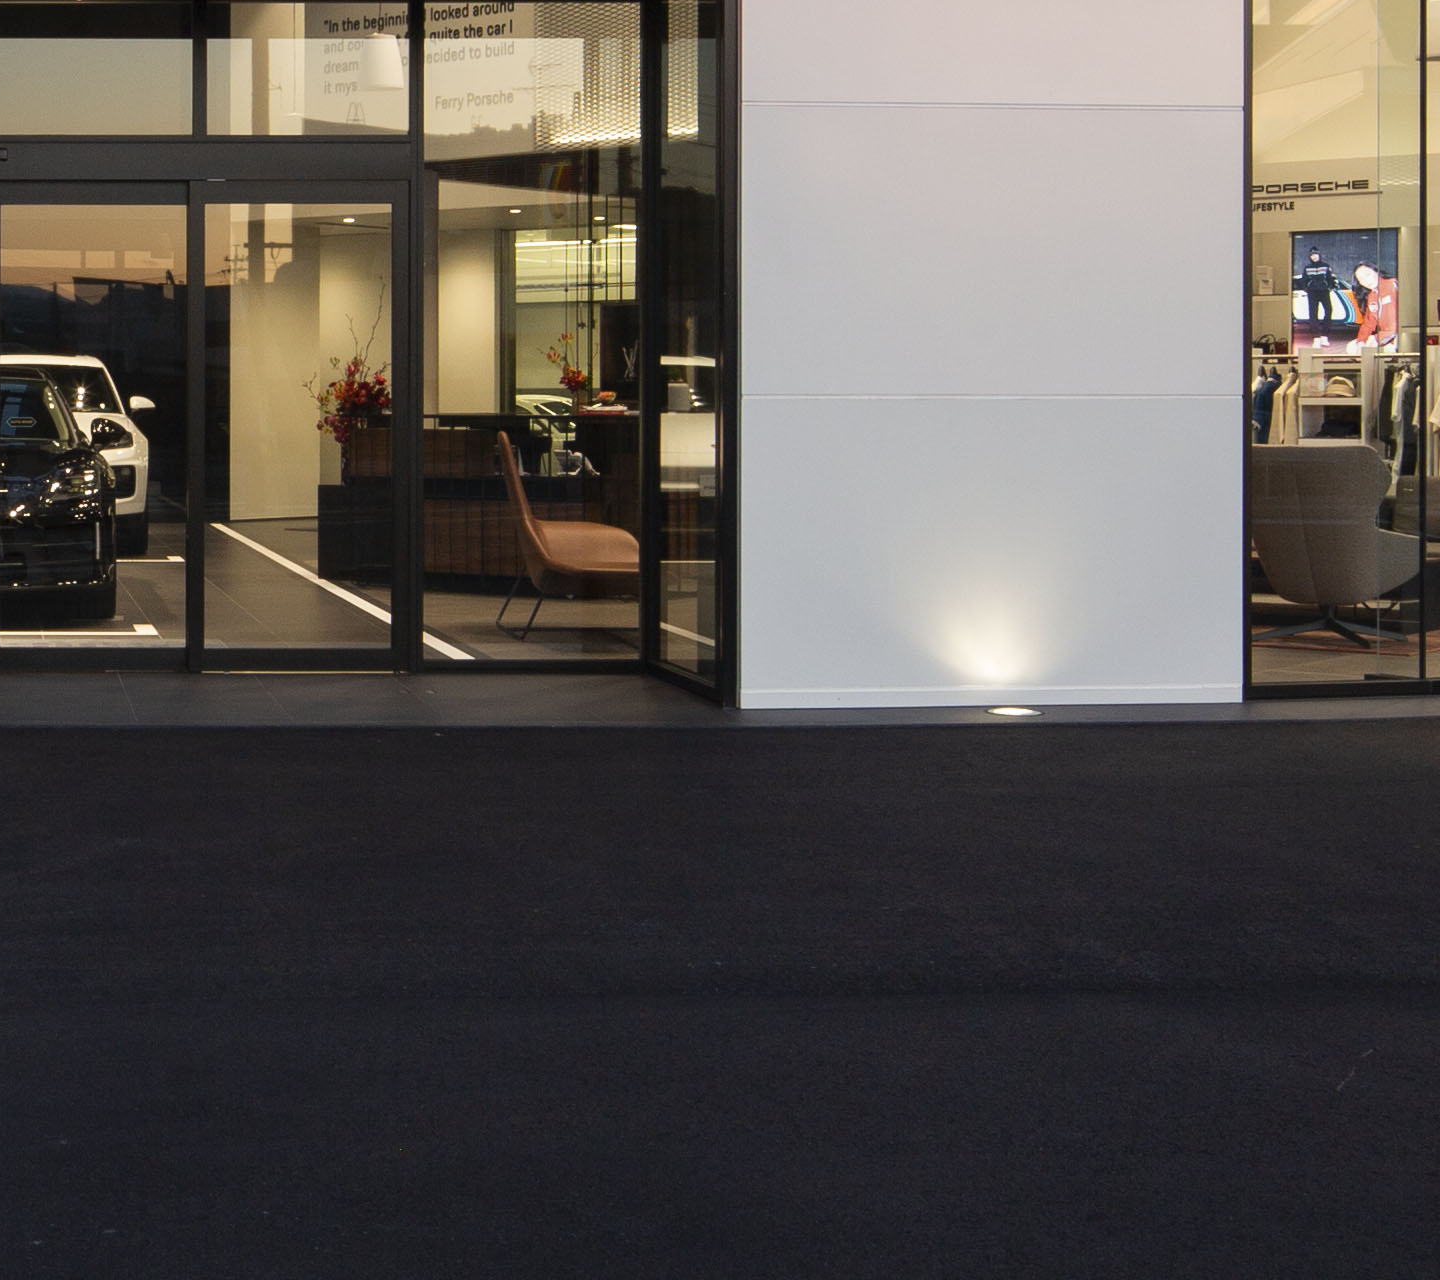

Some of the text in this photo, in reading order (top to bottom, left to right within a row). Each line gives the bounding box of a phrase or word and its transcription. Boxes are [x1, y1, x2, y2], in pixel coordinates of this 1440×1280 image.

[342, 17, 360, 32] the
[363, 10, 410, 31] beginni
[430, 3, 469, 21] looked
[472, 2, 515, 16] around
[324, 38, 344, 54] and
[429, 26, 461, 45] quite
[463, 23, 483, 38] the
[487, 23, 506, 36] car
[324, 58, 359, 75] dream
[426, 47, 465, 65] ecided
[470, 48, 481, 60] to
[485, 43, 515, 58] build
[324, 80, 357, 98] it mys
[435, 91, 514, 112] Ferry Porsche
[1252, 180, 1369, 194] PORSCHE
